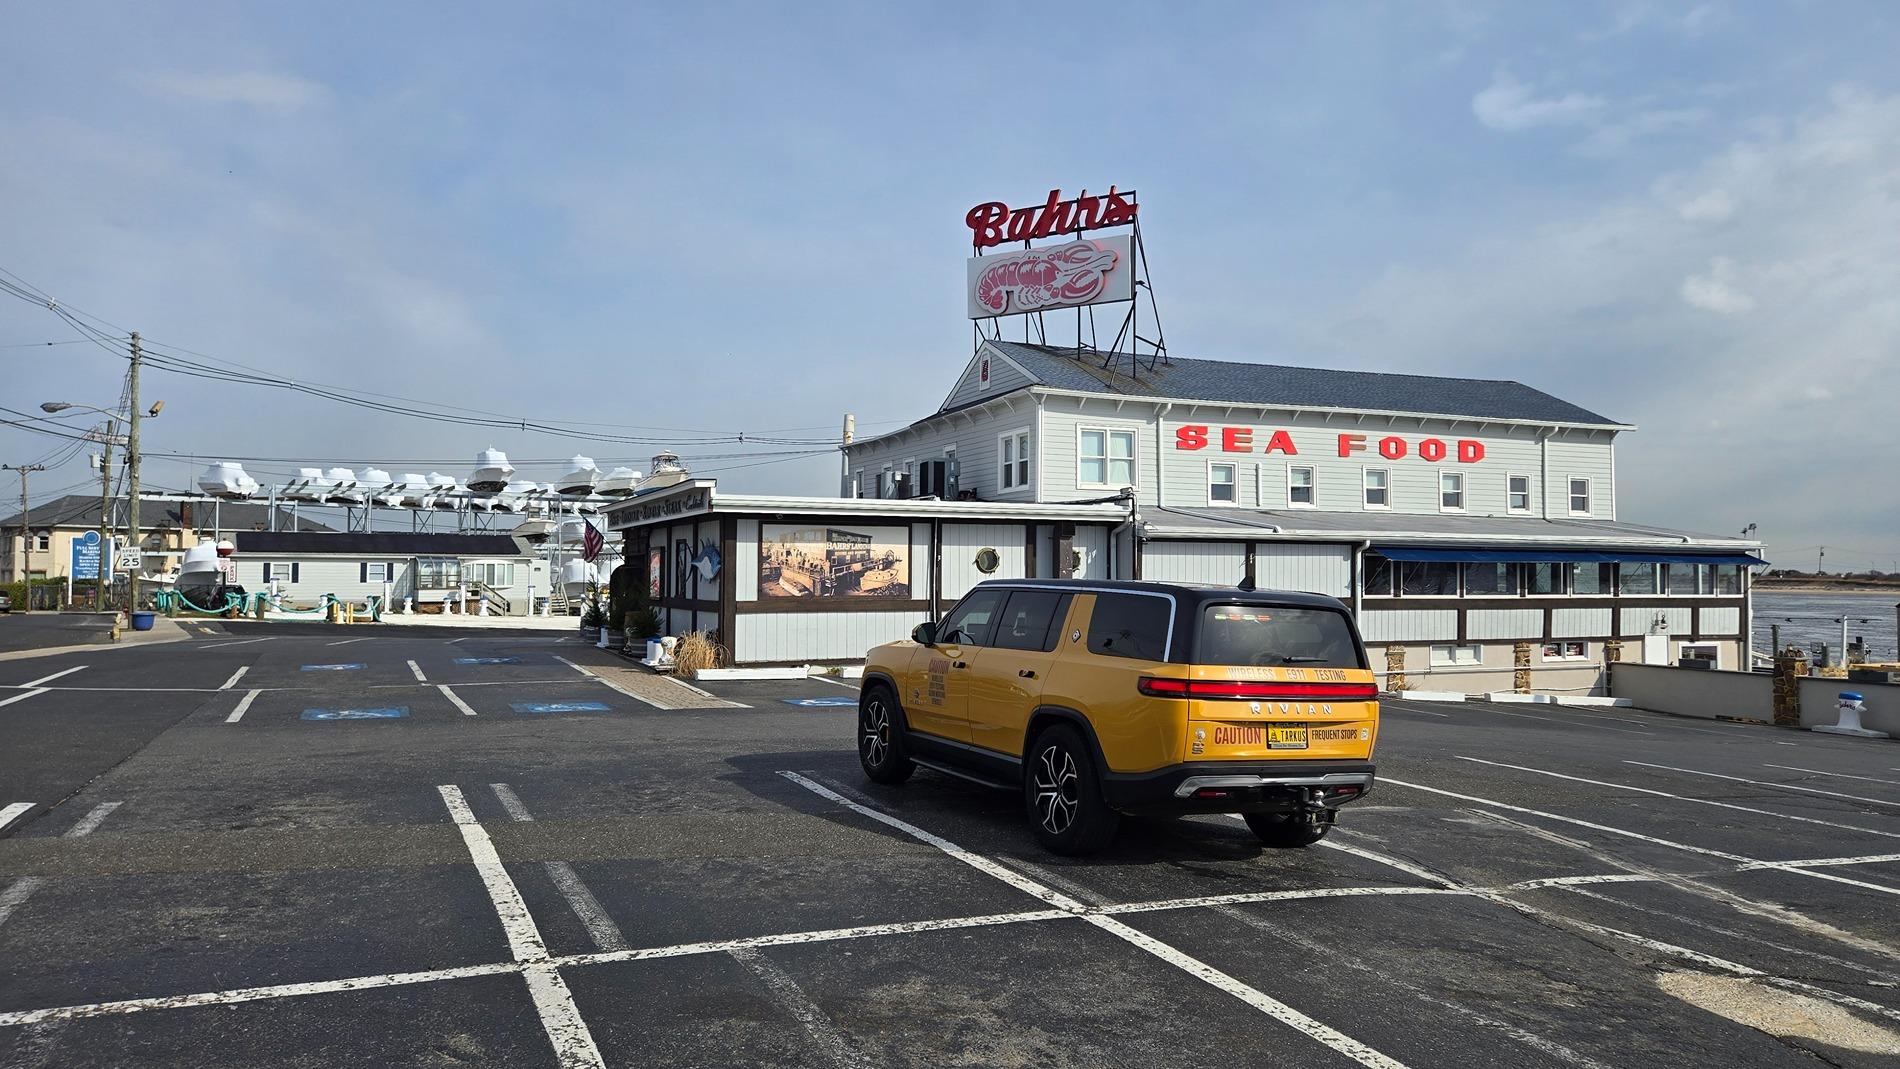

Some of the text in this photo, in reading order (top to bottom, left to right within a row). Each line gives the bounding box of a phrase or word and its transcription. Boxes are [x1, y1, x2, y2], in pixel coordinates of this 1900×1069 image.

[1175, 425, 1485, 463] SEA FOOD
[122, 558, 140, 567] 25
[1227, 667, 1347, 681] WIRELESS E911 TESTING
[1250, 702, 1333, 714] RIVIAN
[1214, 727, 1261, 745] CAUTION
[1281, 730, 1306, 742] TARKUS
[1312, 729, 1357, 740] FREQUENT STOPS
